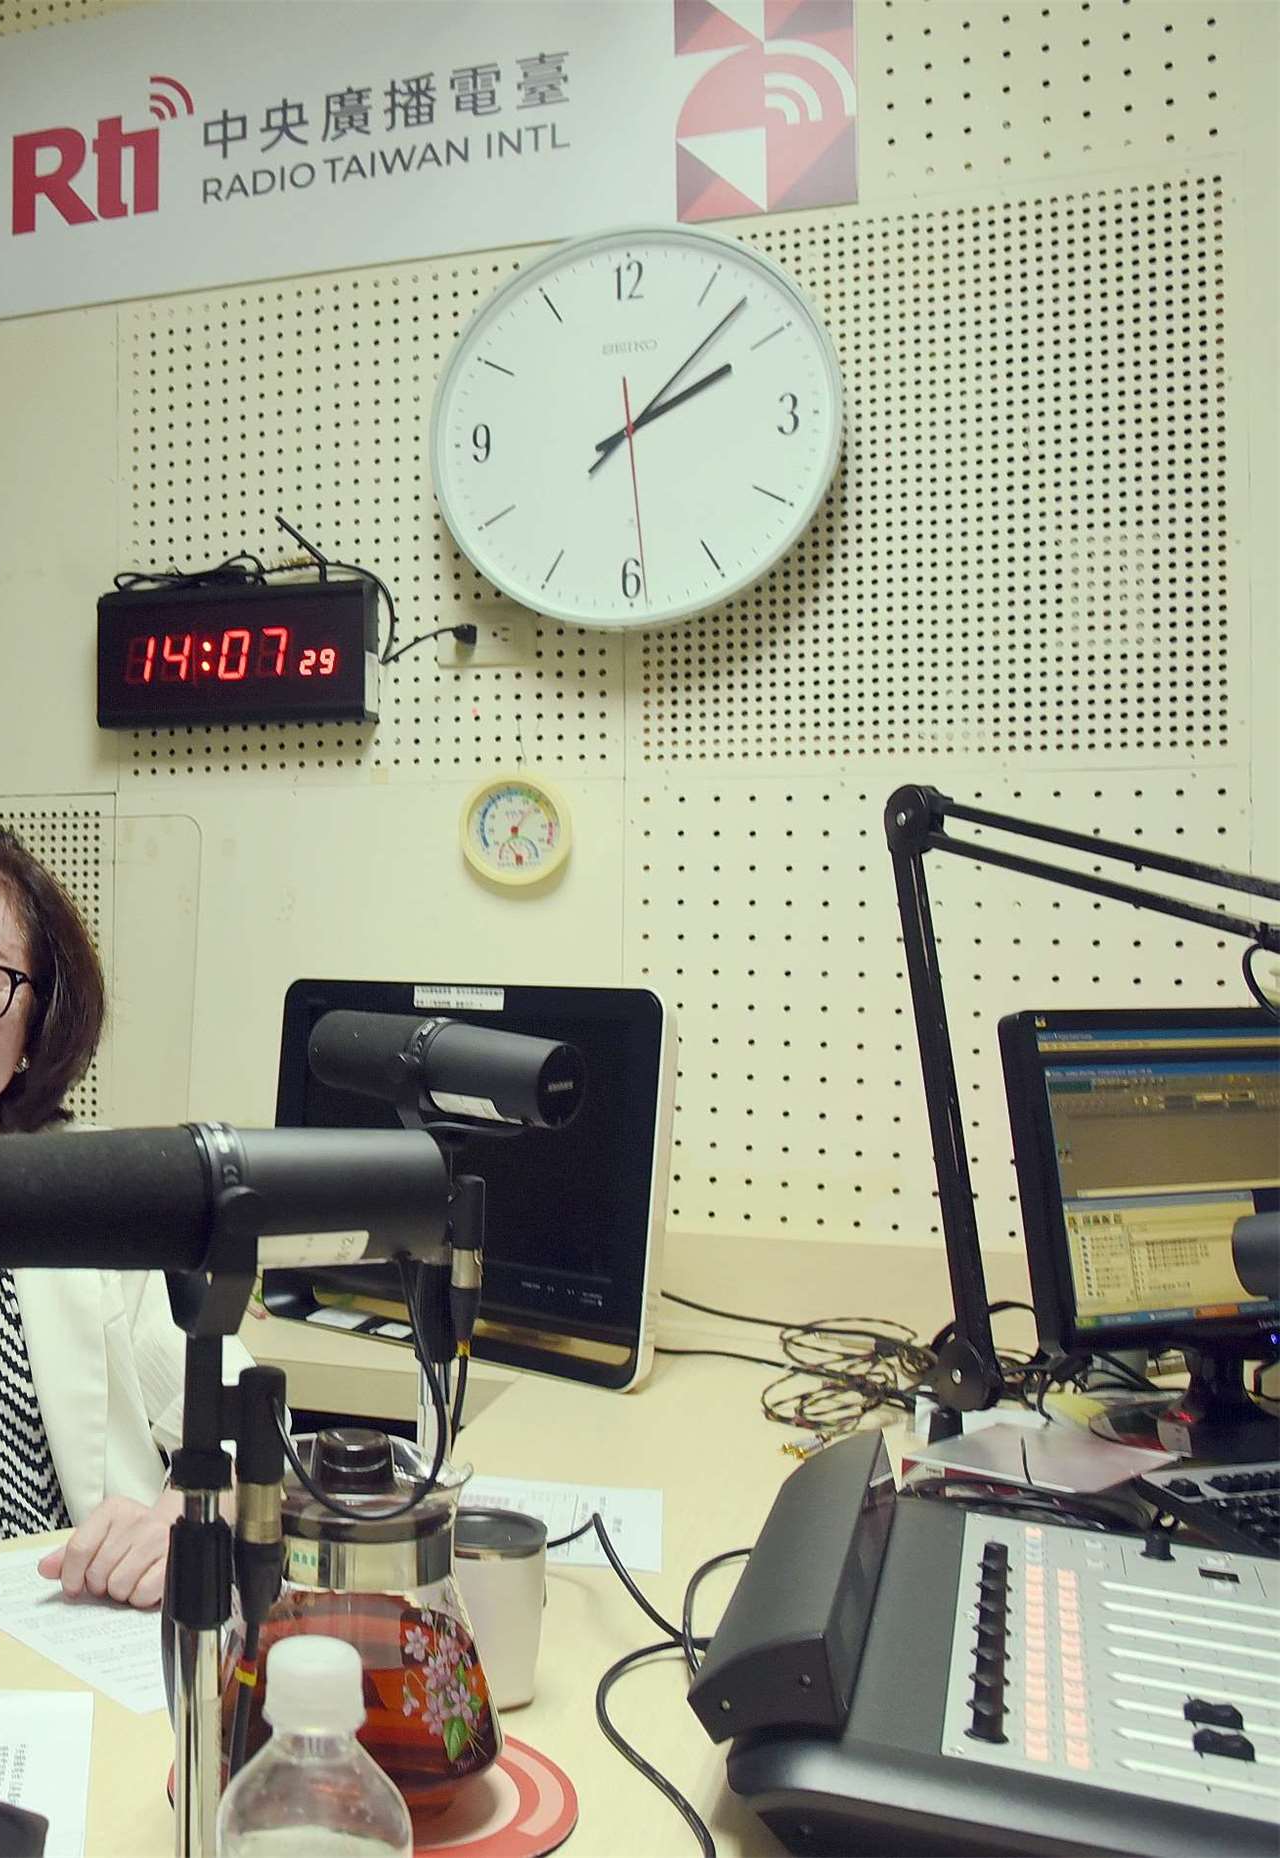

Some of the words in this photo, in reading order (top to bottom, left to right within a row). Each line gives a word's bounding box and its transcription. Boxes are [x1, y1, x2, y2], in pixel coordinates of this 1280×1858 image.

[203, 51, 570, 160] 中央廣播電臺
[12, 114, 160, 236] Rti
[202, 162, 317, 205] RADIO
[322, 135, 469, 185] TAIWAN
[486, 122, 571, 160] INTL
[614, 259, 645, 302] 12
[776, 392, 801, 436] 3
[471, 423, 492, 464] 9
[620, 556, 642, 600] 6
[143, 626, 289, 682] 14:07
[299, 647, 336, 676] 29
